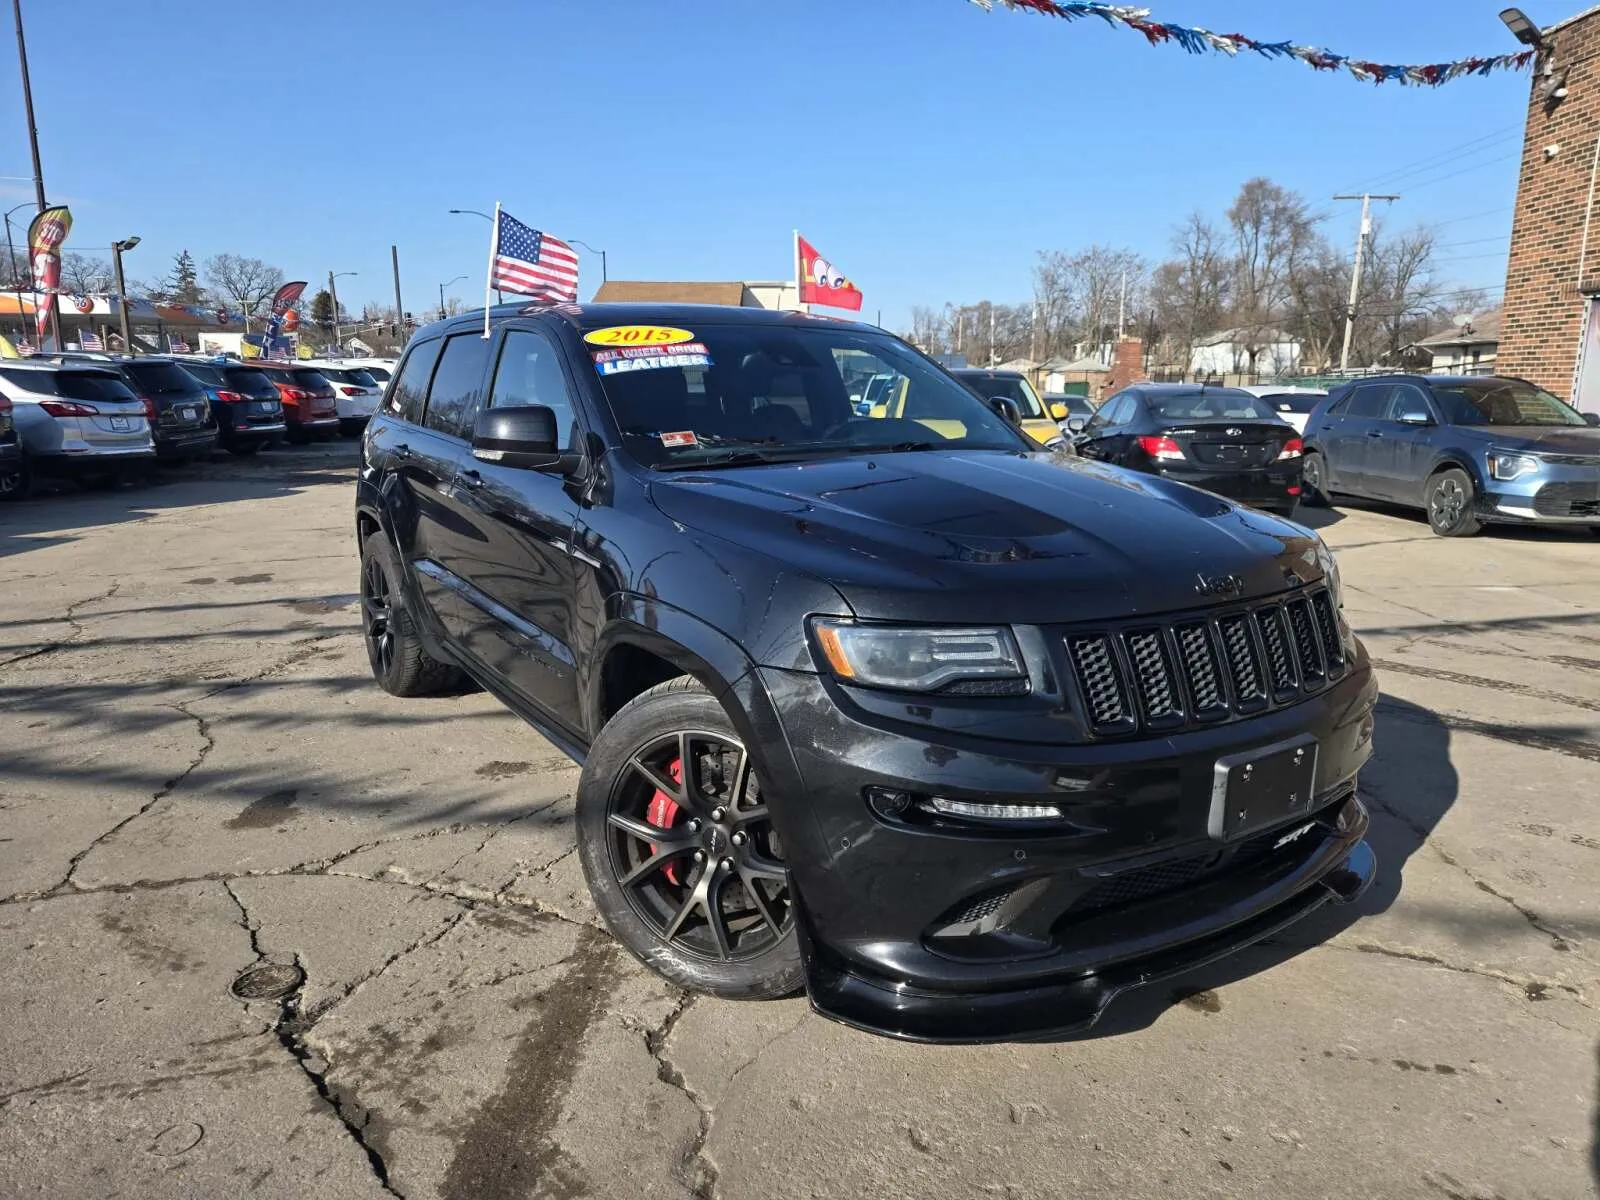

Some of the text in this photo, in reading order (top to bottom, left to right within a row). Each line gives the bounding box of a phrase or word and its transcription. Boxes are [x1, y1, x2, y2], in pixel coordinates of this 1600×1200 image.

[605, 329, 672, 343] 2015
[595, 343, 706, 363] ALL WHEEL DRIVE
[603, 354, 710, 375] LEATHER
